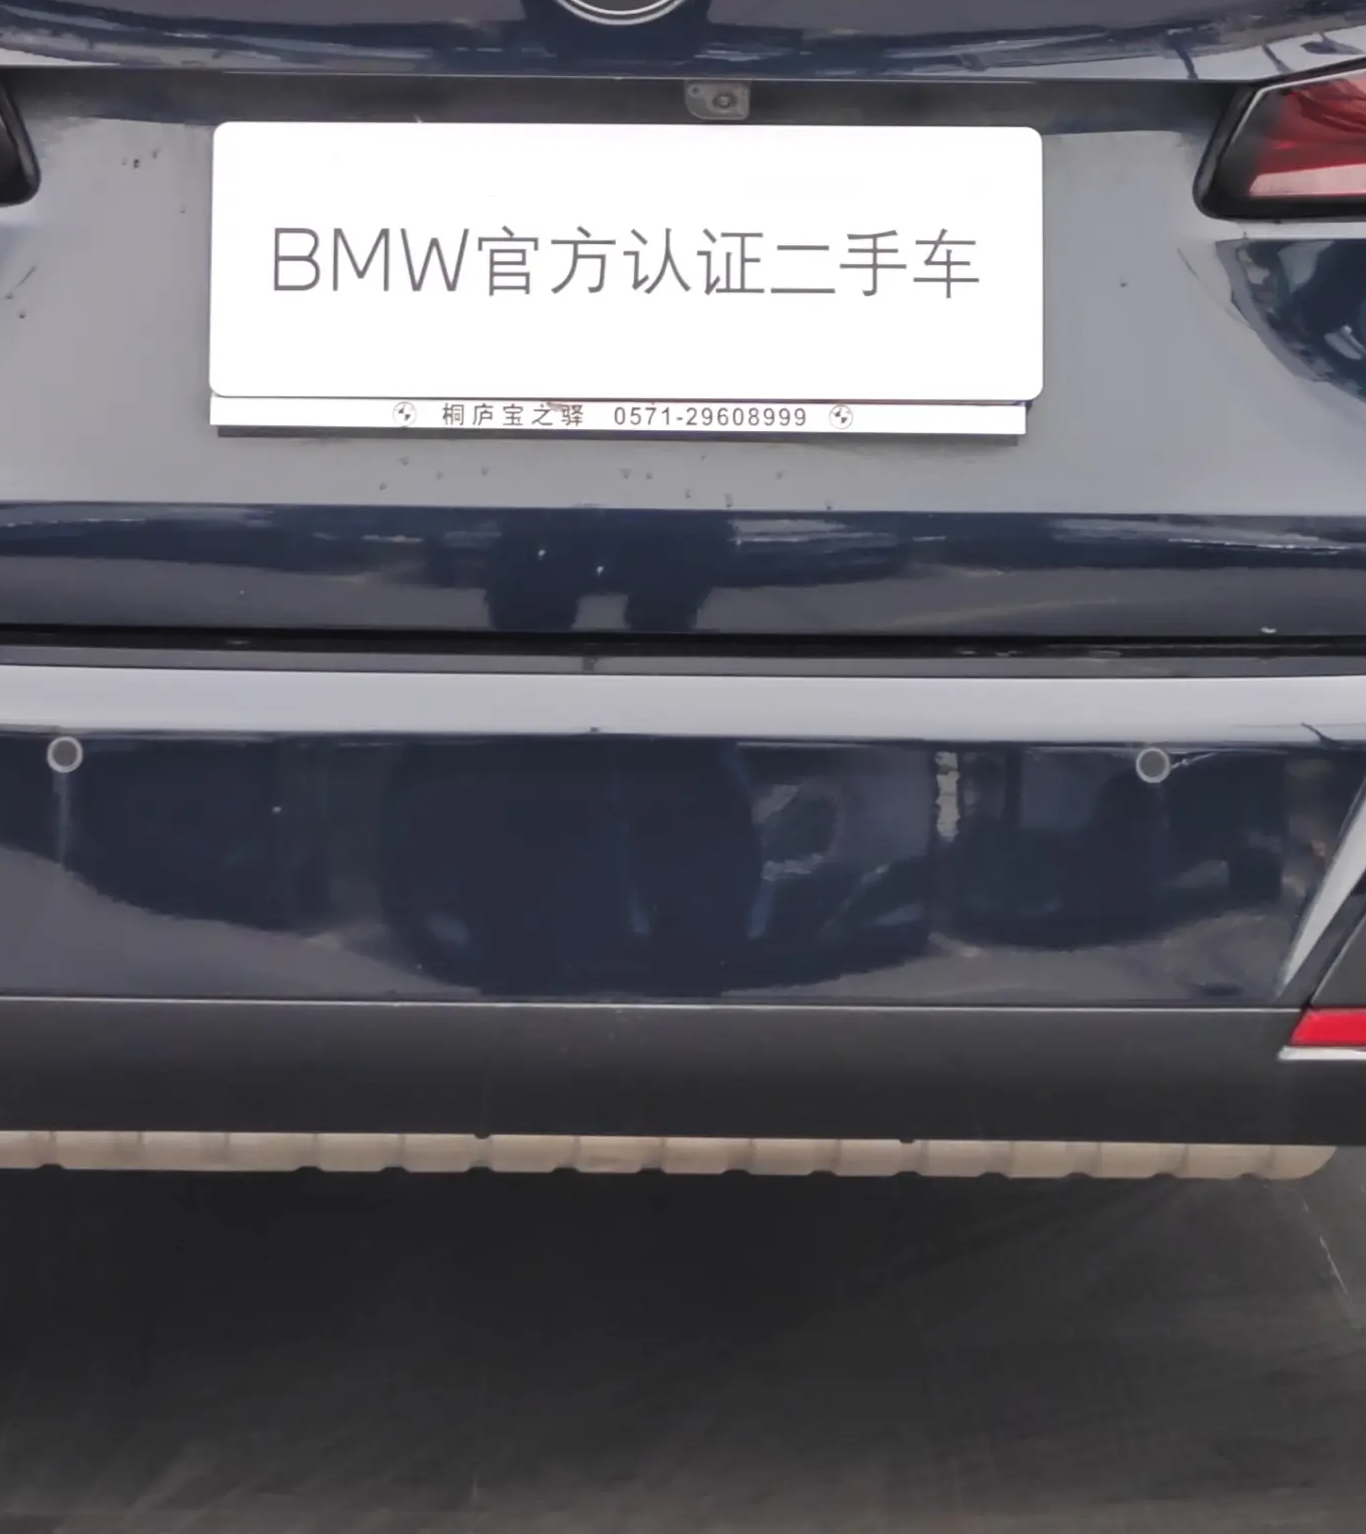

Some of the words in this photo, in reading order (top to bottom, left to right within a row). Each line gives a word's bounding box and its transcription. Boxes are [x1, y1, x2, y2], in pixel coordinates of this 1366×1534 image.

[271, 224, 982, 300] BMW官方认证二手车
[613, 406, 808, 427] 0571-29608999
